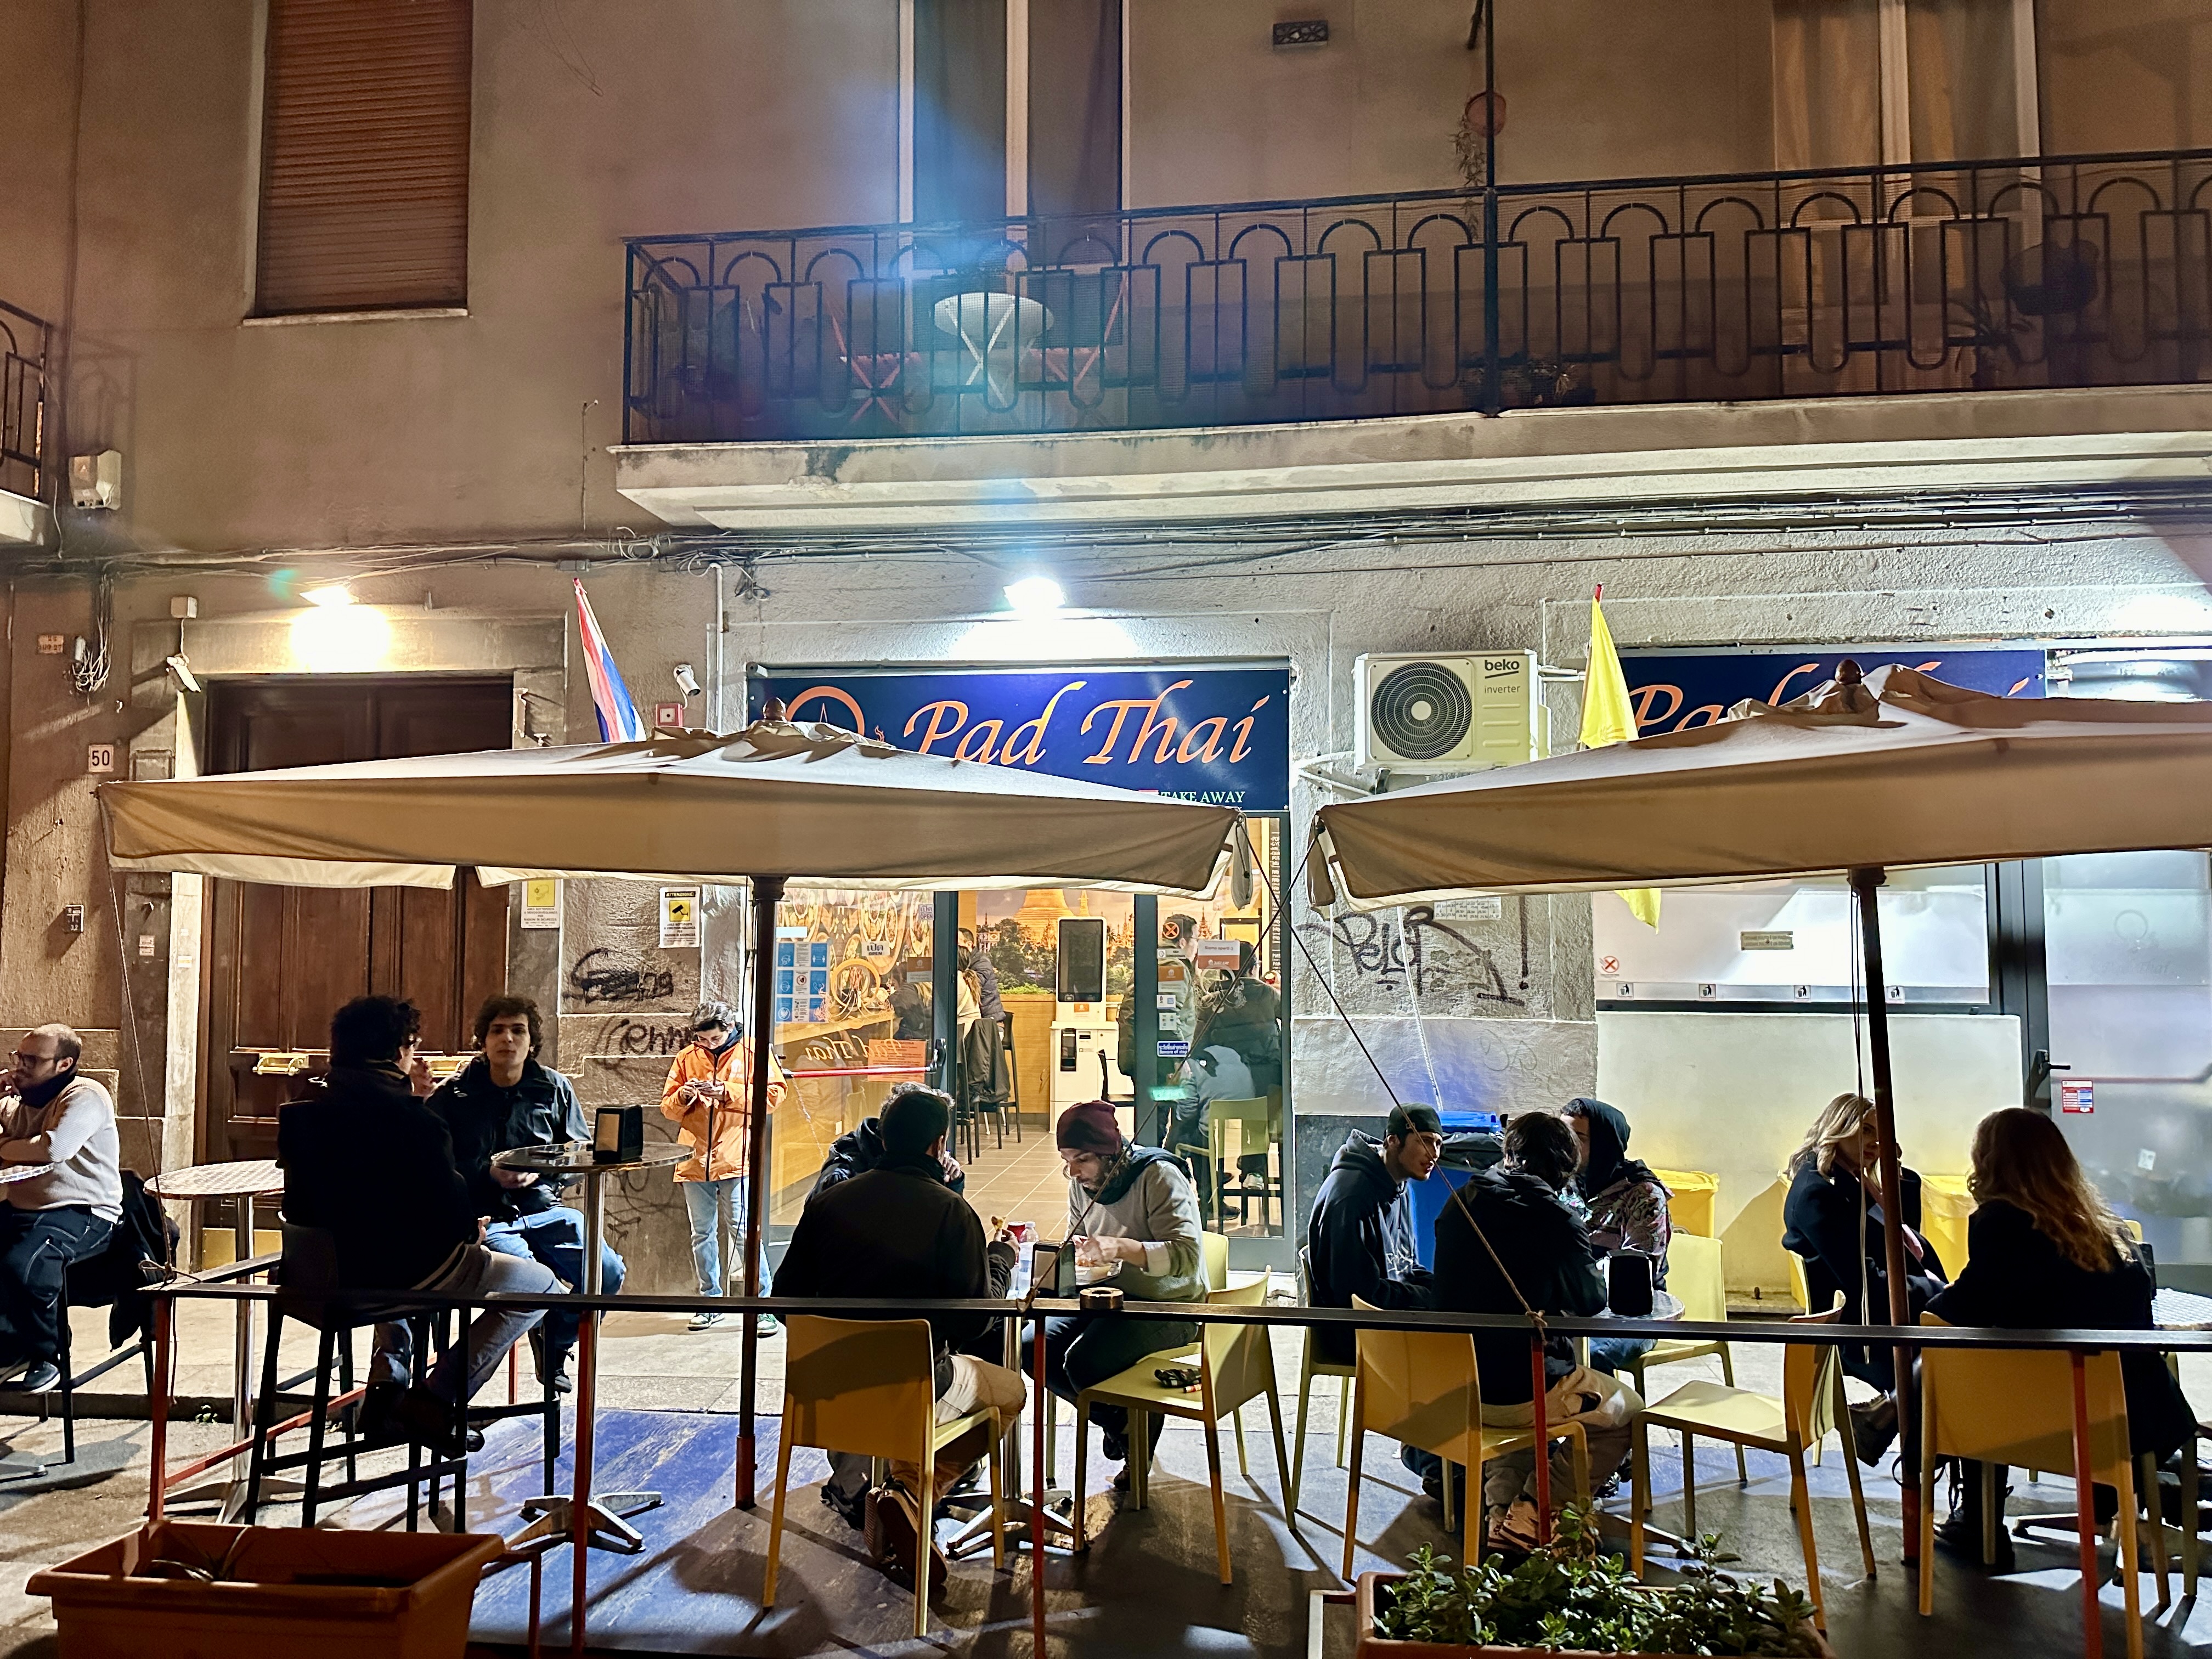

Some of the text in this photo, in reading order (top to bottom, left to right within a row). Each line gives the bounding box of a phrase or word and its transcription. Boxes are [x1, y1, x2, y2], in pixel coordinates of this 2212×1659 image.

[1485, 659, 1520, 671] beko
[1485, 685, 1521, 694] inverter
[902, 680, 1271, 765] Pad Thai
[92, 750, 110, 766] 50
[1200, 791, 1245, 803] AWAY
